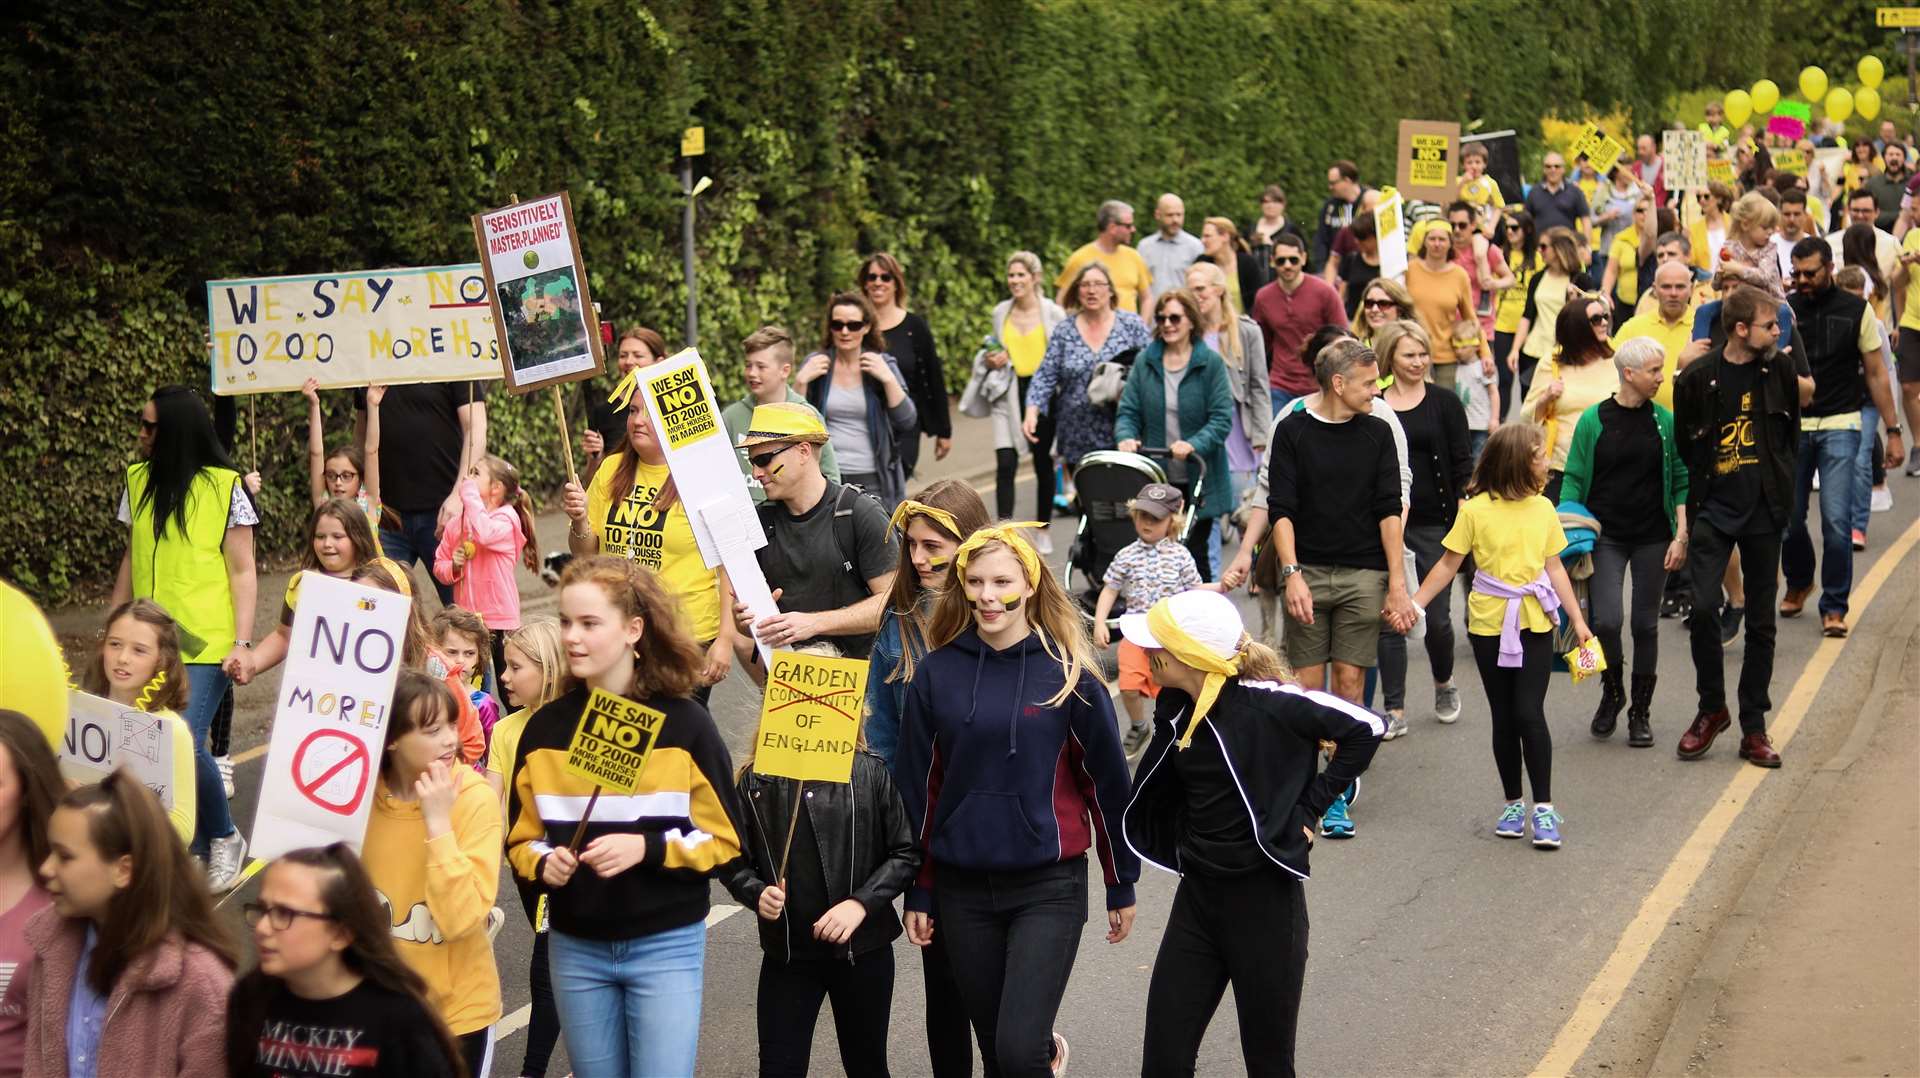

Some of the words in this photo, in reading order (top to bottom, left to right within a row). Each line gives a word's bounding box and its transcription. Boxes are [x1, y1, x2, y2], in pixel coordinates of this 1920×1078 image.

[1418, 149, 1440, 161] NO
[485, 202, 559, 233] "SENSITIVELY
[490, 221, 564, 254] MASTER-PLANNED"
[226, 285, 279, 324] WE
[312, 278, 393, 318] SAY
[427, 271, 487, 304] NO
[215, 330, 257, 366] TO
[263, 330, 334, 363] 2000
[652, 377, 673, 394] WE
[673, 367, 695, 386] SAY
[662, 385, 697, 412] NO
[664, 413, 680, 428] TO
[680, 402, 709, 421] 2000
[667, 422, 686, 435] MORE
[686, 412, 712, 428] HOUSES
[669, 433, 680, 444] IN
[679, 419, 715, 440] MARDEN
[614, 500, 660, 528] NO
[605, 526, 623, 544] TO
[626, 530, 663, 549] 2000
[605, 542, 627, 555] MORE
[632, 547, 662, 560] OUSES
[309, 615, 395, 674] NO
[773, 661, 858, 689] GARDEN
[287, 685, 386, 730] MORE!
[594, 694, 622, 717] WE
[623, 706, 658, 730] SAY
[769, 687, 862, 711] COMMUNITY
[591, 714, 641, 749] NO
[795, 714, 822, 730] OF
[579, 734, 598, 753] TO
[600, 744, 642, 770] 2000
[763, 732, 854, 755] ENGLAND
[569, 755, 582, 768] IN
[583, 760, 634, 788] MARDEN
[573, 747, 598, 763] MORE
[600, 758, 637, 779] HOUSES
[261, 1019, 364, 1052] MICKEY
[256, 1040, 352, 1077] MINNIE
